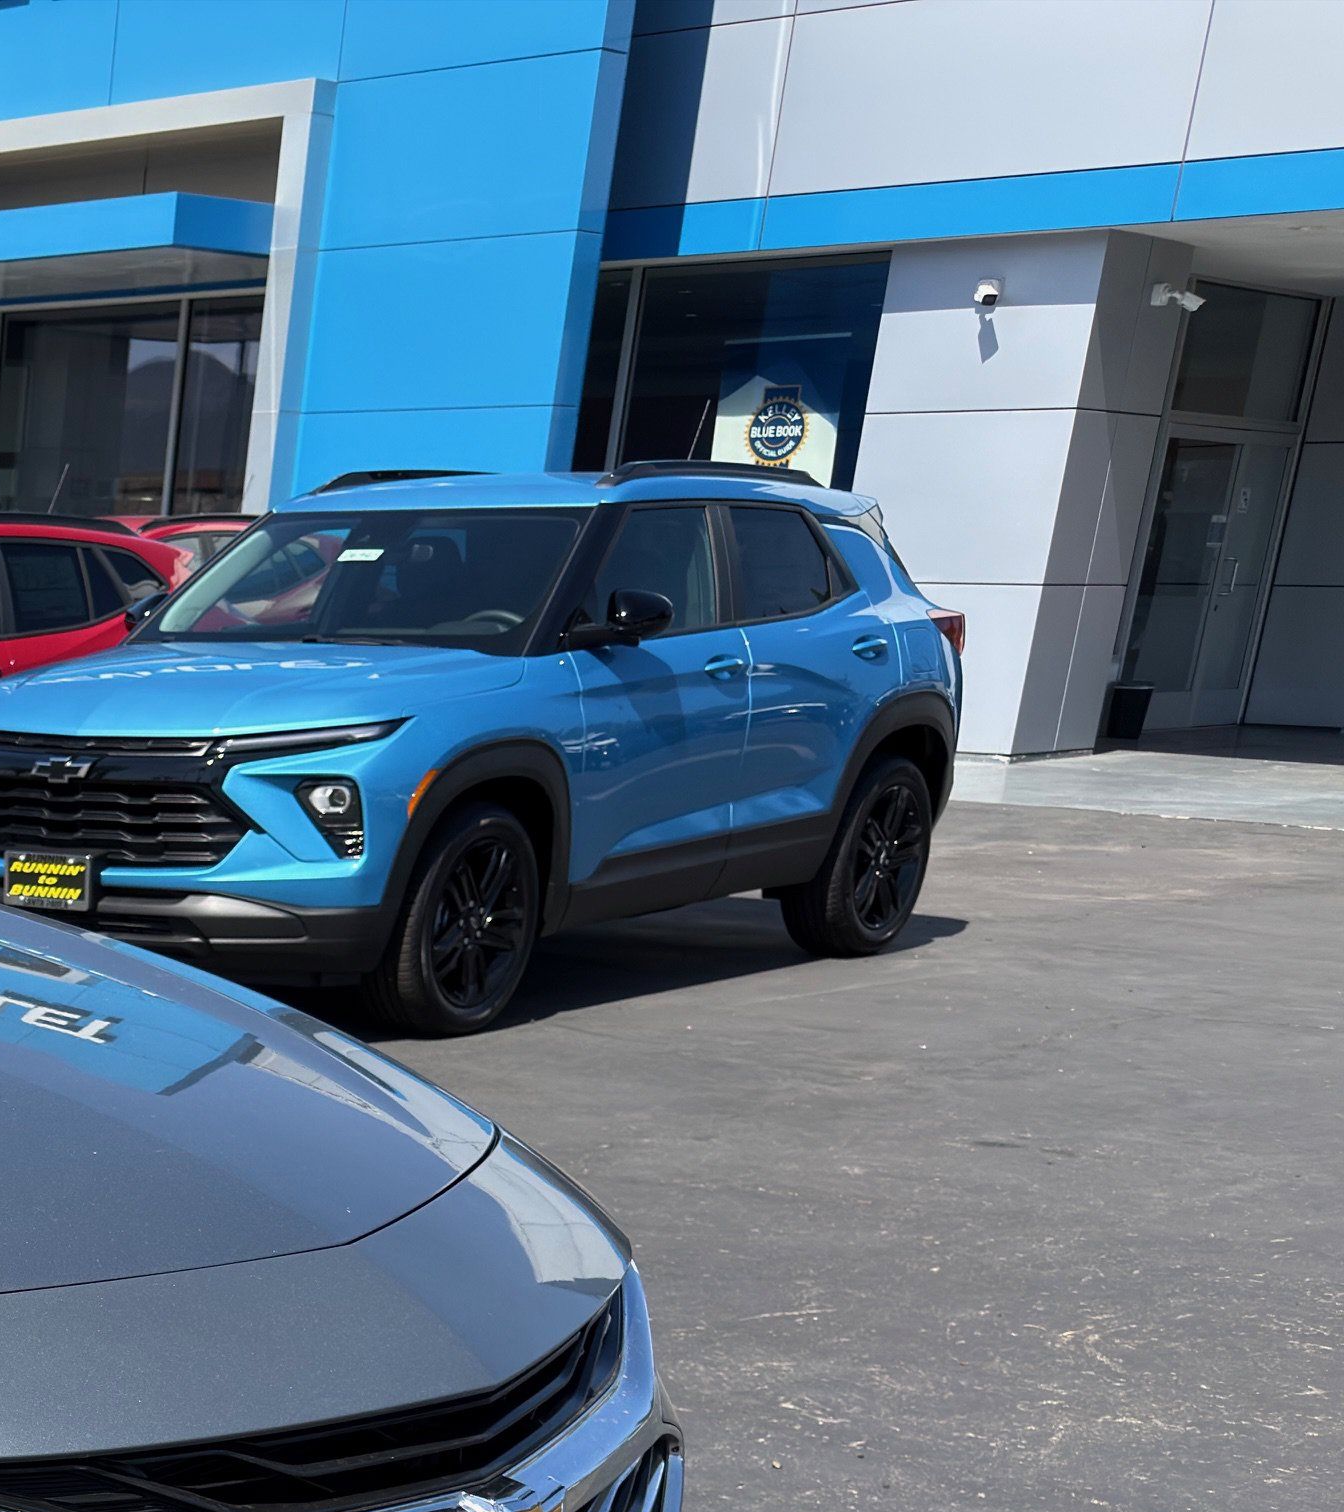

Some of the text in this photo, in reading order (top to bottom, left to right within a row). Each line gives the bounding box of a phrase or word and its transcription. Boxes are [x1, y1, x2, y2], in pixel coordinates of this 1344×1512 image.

[758, 404, 801, 422] KELLEY
[750, 425, 802, 438] BLUE BOOK
[9, 861, 86, 876] RUNNIN'
[37, 874, 58, 885] to
[8, 883, 82, 900] BUNNIN
